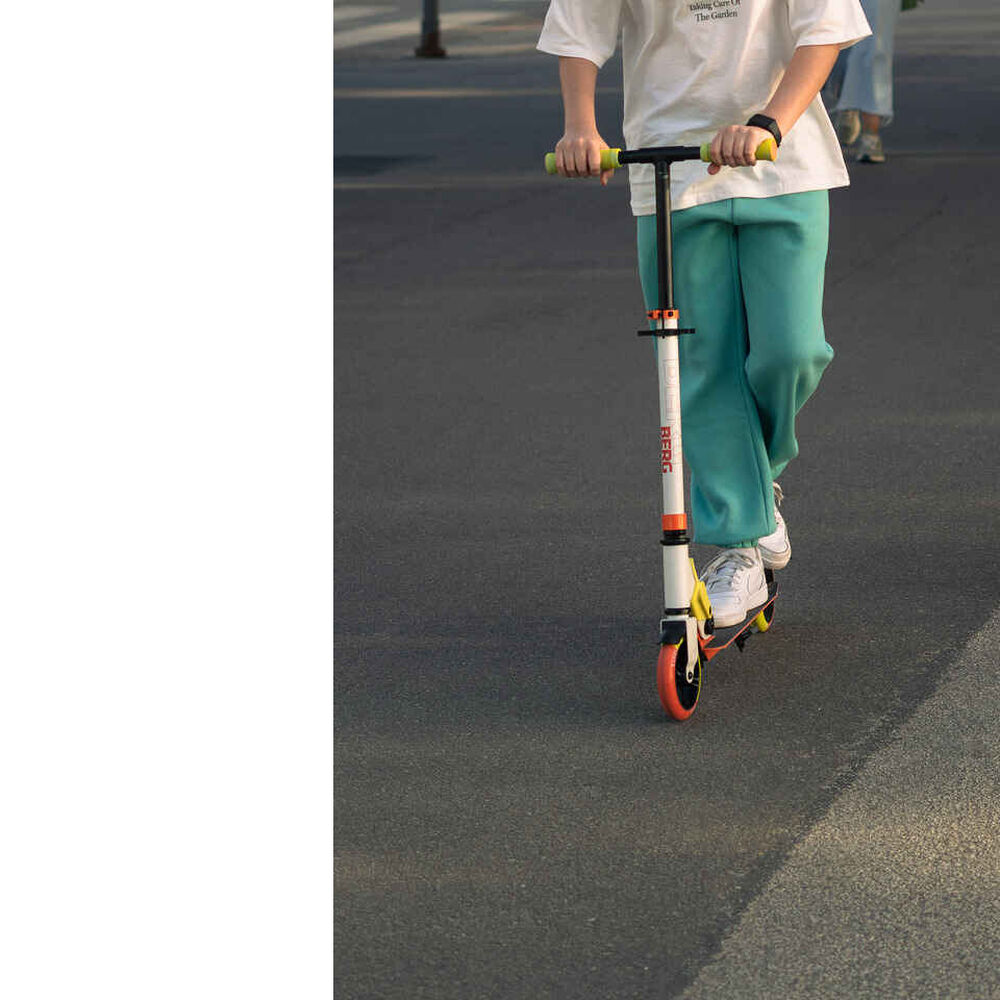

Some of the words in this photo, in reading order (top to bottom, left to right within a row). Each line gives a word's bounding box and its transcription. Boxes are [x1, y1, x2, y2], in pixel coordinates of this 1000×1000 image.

[713, 0, 730, 8] Care
[695, 12, 710, 21] The
[711, 9, 738, 19] Garden
[661, 426, 672, 474] BERG
